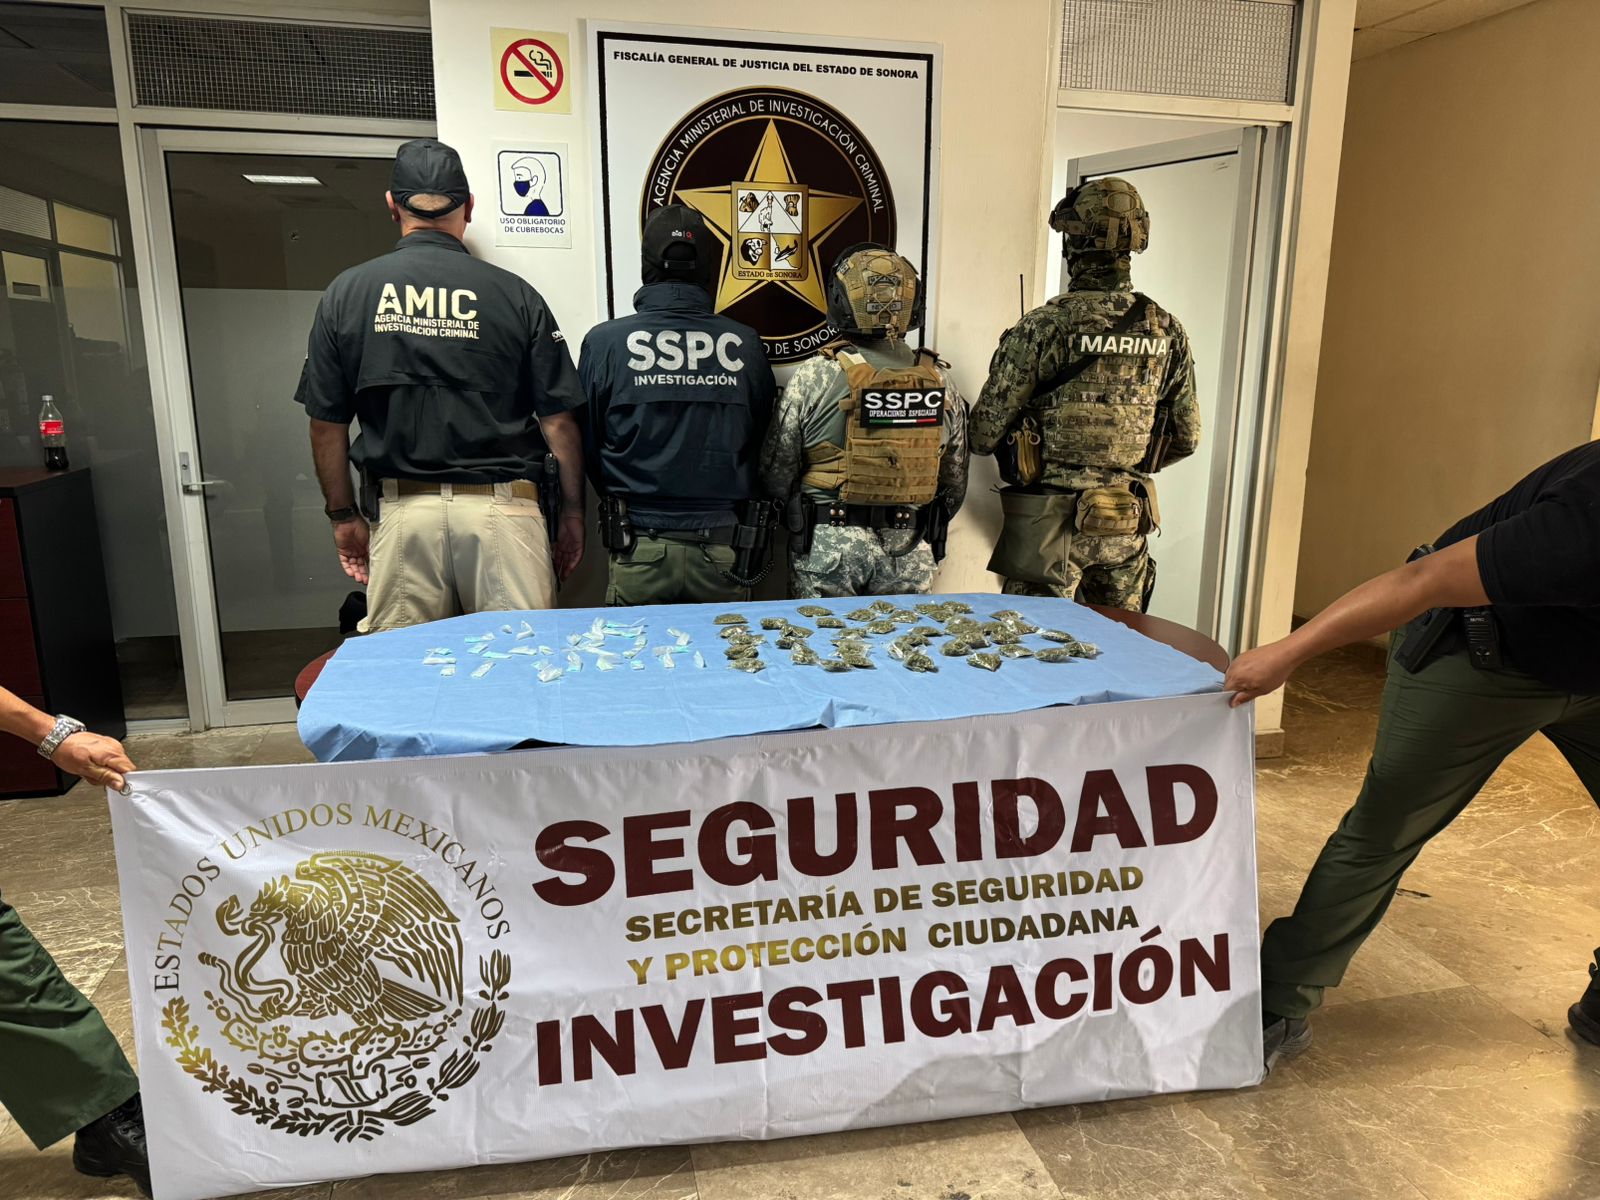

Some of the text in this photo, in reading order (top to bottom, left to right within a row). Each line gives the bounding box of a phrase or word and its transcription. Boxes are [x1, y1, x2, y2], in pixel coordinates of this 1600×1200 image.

[614, 51, 919, 79] FISCALÍA GENERAL DE JUSTICIA DEL ESTADO DE SONORA
[653, 99, 884, 213] AGENCIA MINISTERIAL DE INVESTIGACIÓN CRIMINAL
[515, 226, 564, 234] CUBREBOCAS
[774, 271, 803, 279] SONORA
[376, 283, 478, 320] AMIC
[374, 314, 480, 330] AGENCIA MINISTERIAL DE
[374, 323, 480, 339] INVESTIGACION CRIMINAL
[626, 330, 745, 372] SSPC
[775, 342, 790, 355] DE
[793, 325, 840, 352] SONOR
[1080, 335, 1167, 356] MARINA
[634, 373, 737, 386] INVESTIGACIÓN
[864, 391, 942, 409] SSPC
[869, 409, 937, 417] OPERACIONES ESPECIALES
[531, 763, 1219, 907] SEGURIDAD
[154, 802, 511, 992] ESTADOS UNIDOS MEXICANOS
[625, 866, 1144, 942] SECRETARÍA DE SEGURIDAD
[626, 905, 1140, 985] Y PROTECCIÓN CIUDADANA
[536, 925, 1232, 1087] INVESTIGACIÓN
